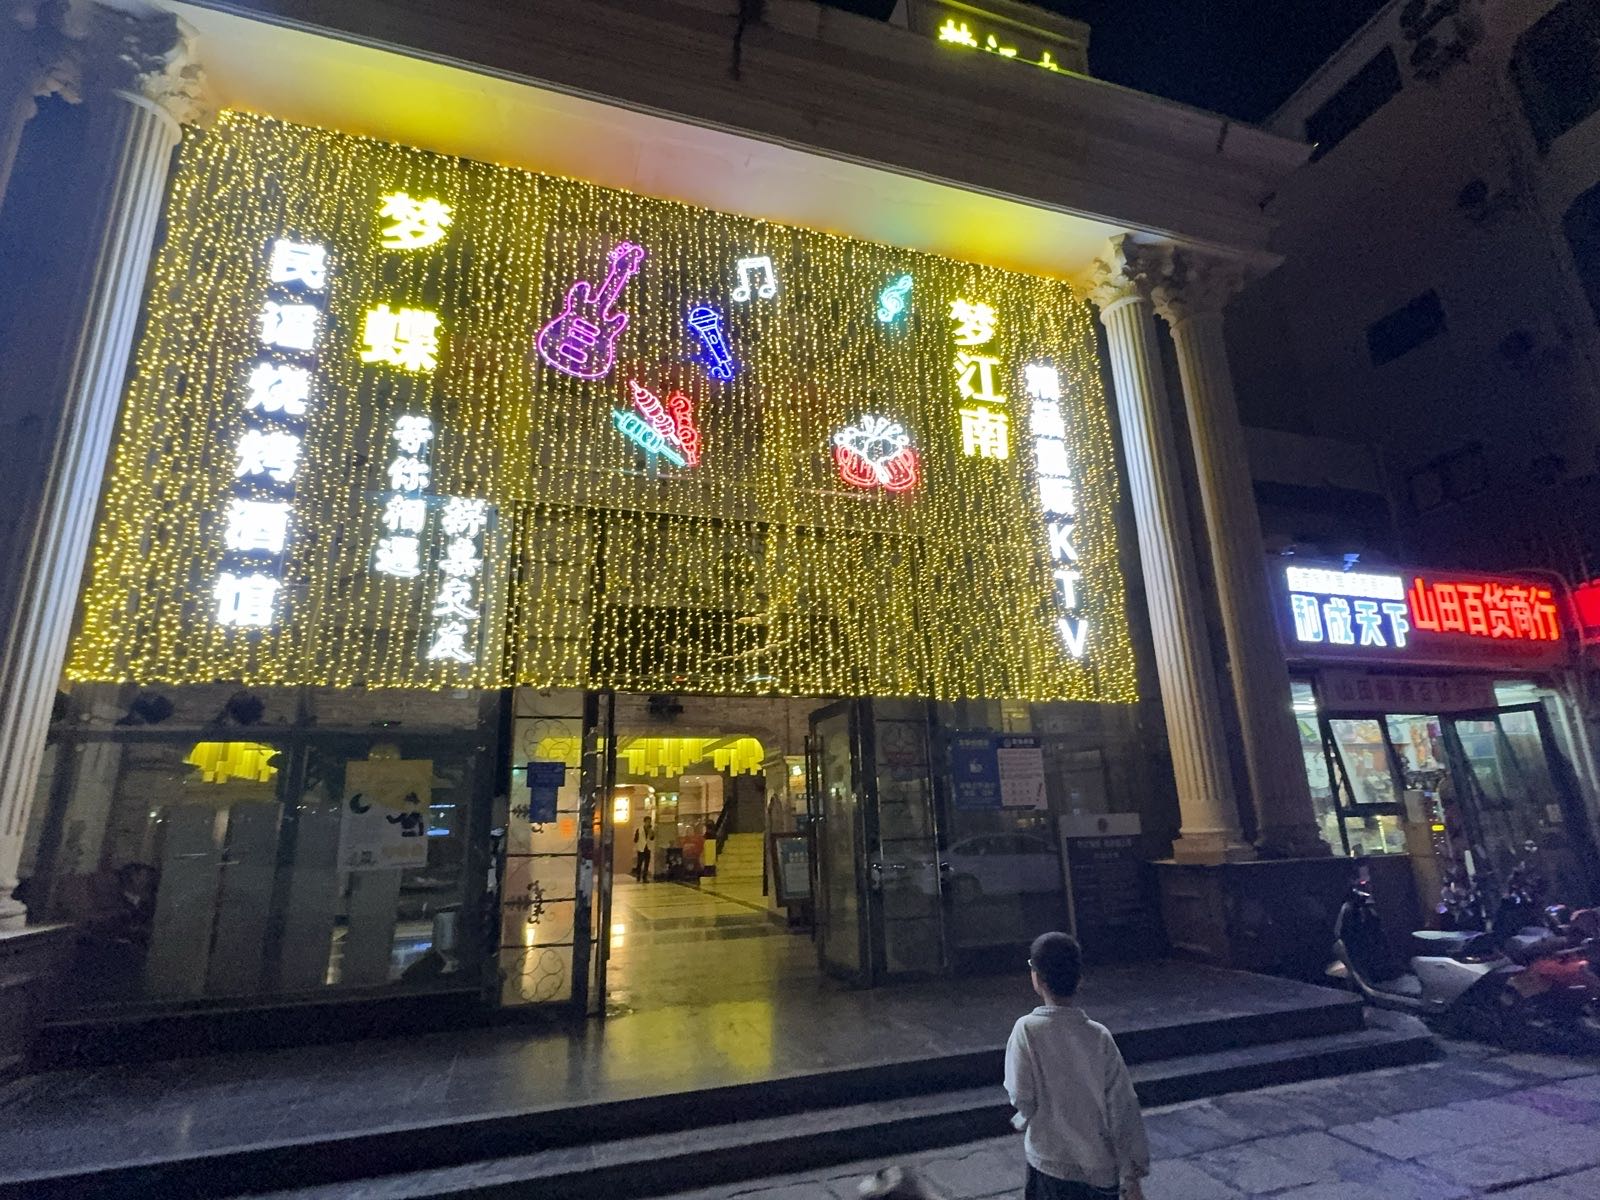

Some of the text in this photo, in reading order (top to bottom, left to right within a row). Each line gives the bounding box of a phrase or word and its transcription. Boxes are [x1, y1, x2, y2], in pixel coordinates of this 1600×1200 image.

[361, 191, 454, 372] 梦蝶
[950, 298, 1010, 460] 梦江南
[1290, 594, 1410, 648] 和成天下
[1408, 577, 1561, 641] 山田百货商行
